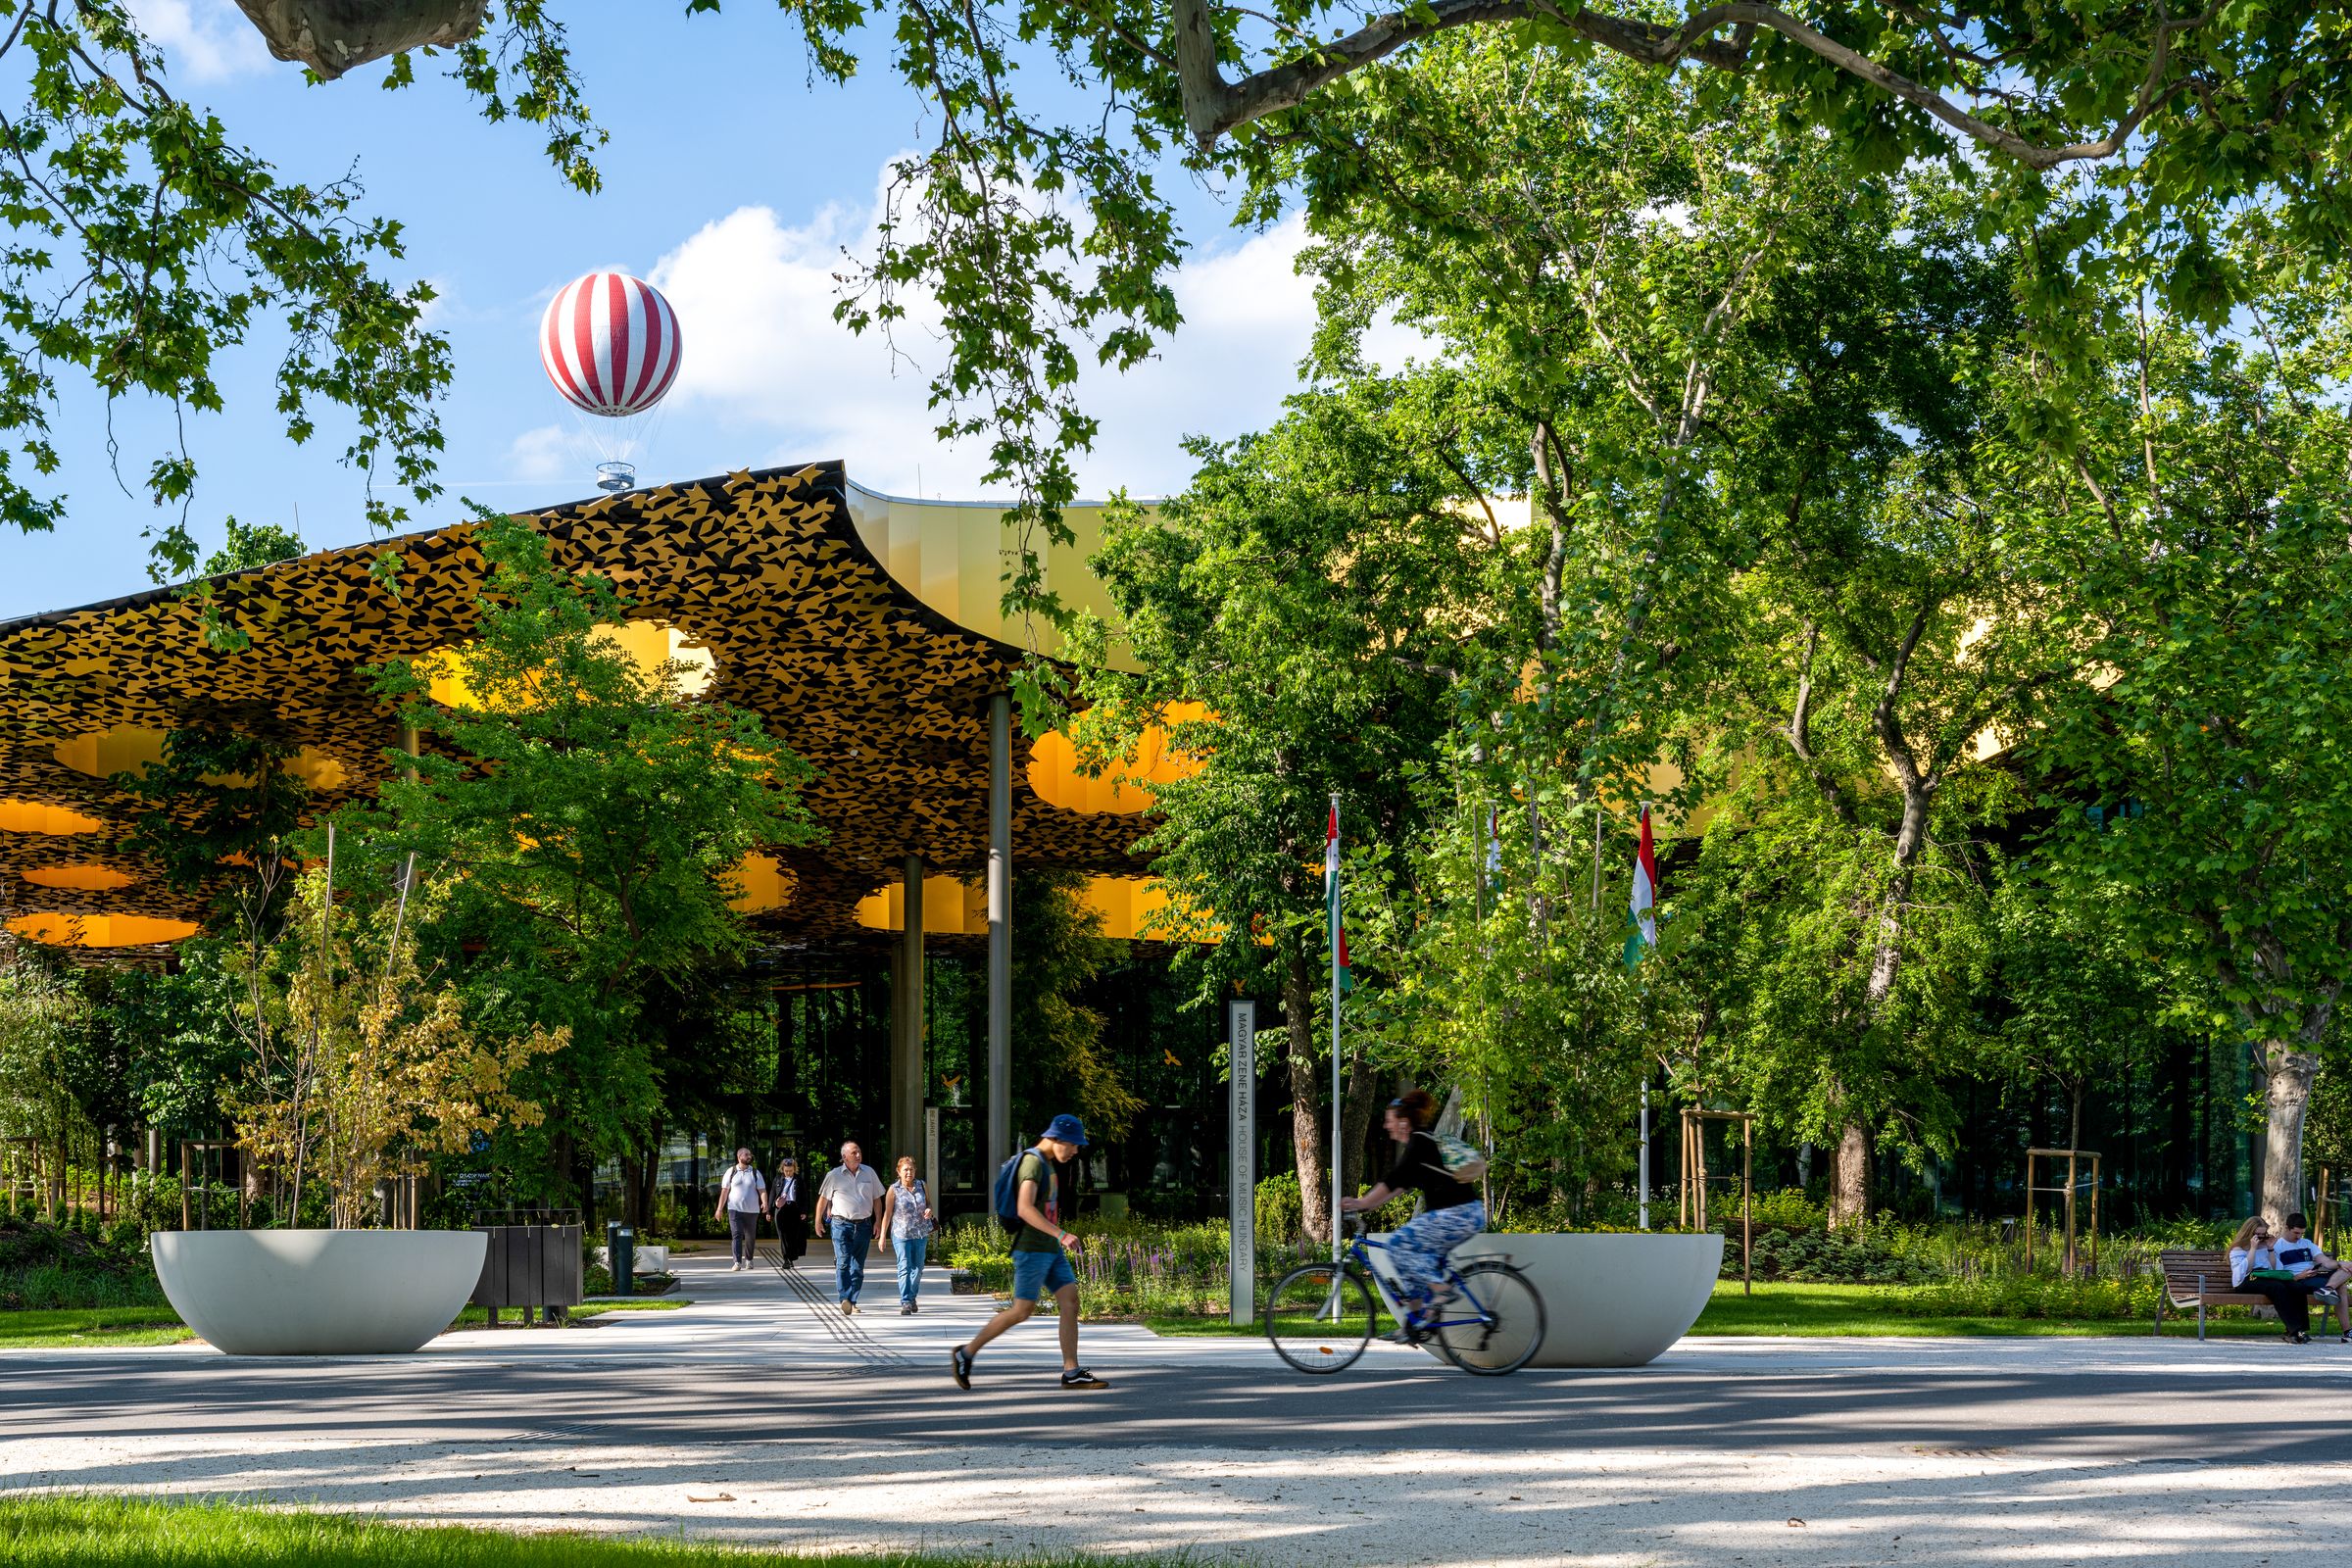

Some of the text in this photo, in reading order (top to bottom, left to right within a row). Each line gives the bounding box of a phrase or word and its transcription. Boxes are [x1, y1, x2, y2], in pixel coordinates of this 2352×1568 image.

[1238, 1012, 1248, 1058] MAGYAR
[1238, 1060, 1248, 1089] ZENE
[1238, 1092, 1250, 1121] HÁZA
[1238, 1125, 1248, 1163] HOUSE
[1238, 1165, 1248, 1179] OF
[1238, 1220, 1248, 1272] HUNGARY
